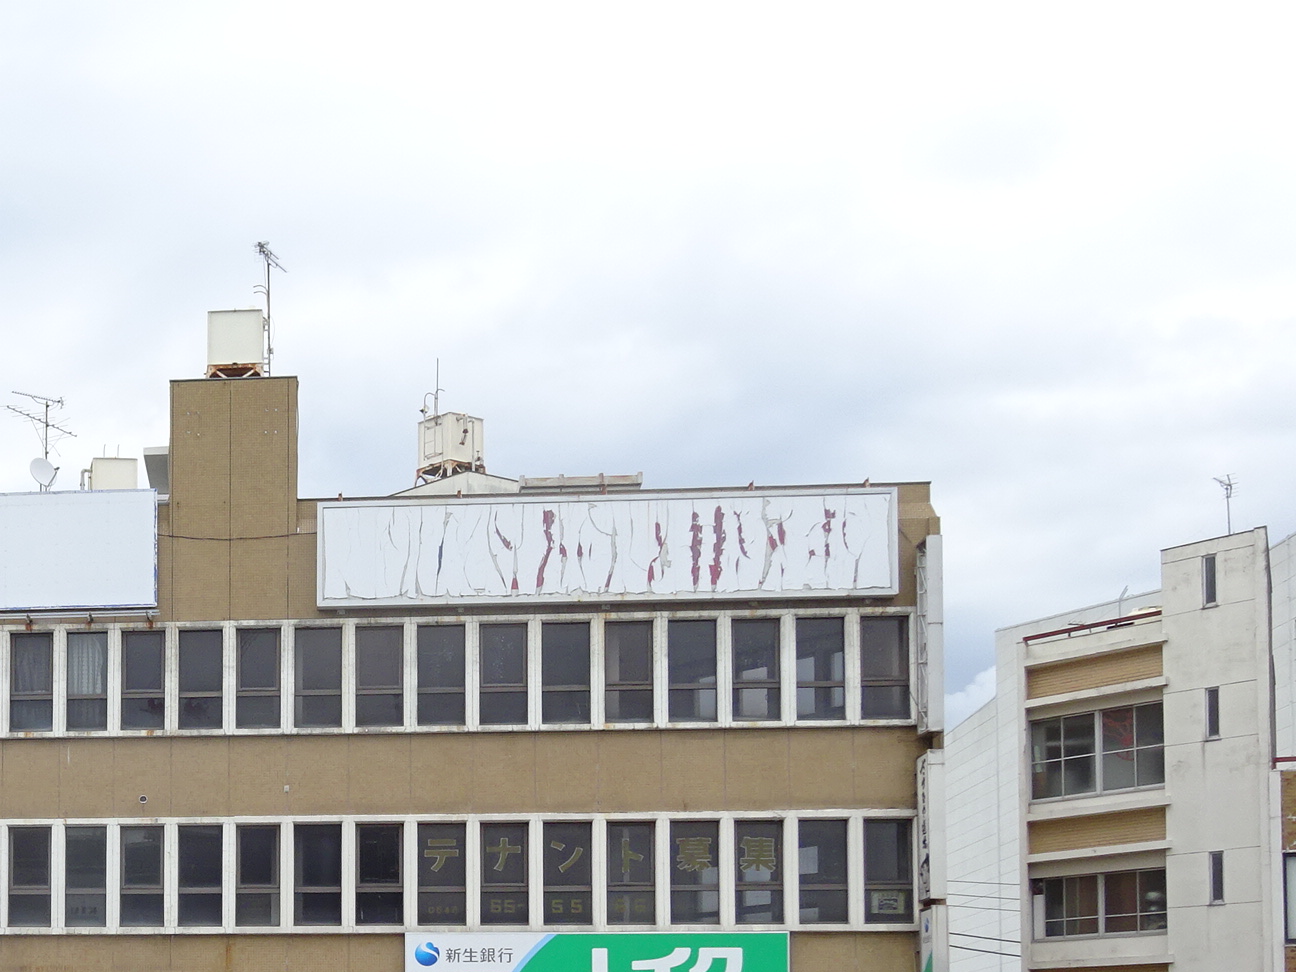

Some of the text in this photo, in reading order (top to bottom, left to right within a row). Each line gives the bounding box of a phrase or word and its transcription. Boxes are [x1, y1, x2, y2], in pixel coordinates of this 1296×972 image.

[424, 836, 776, 873] テナント募集
[445, 947, 514, 963] 新生銀行
